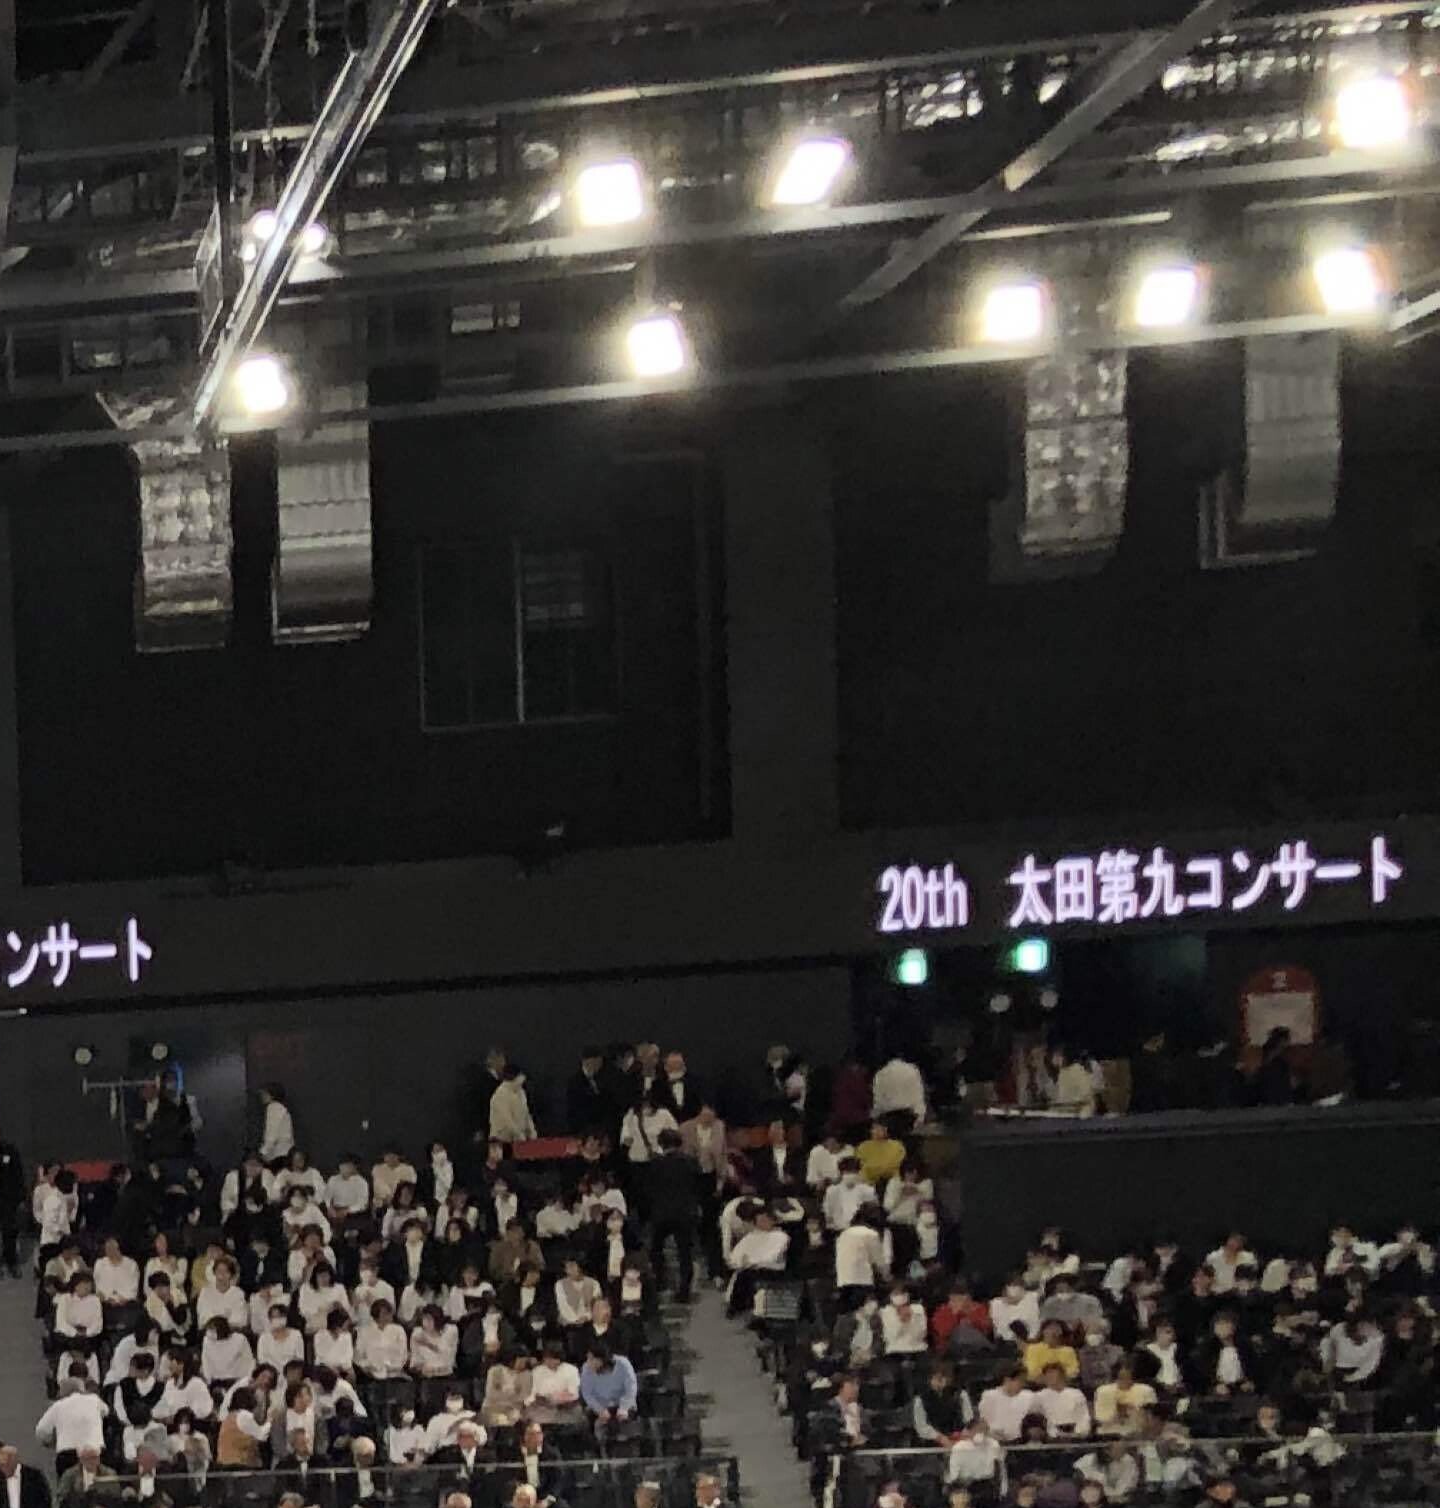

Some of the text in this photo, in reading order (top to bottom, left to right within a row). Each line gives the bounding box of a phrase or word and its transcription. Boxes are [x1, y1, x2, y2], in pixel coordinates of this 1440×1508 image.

[878, 836, 1403, 932] 20th 太田第九コンサート
